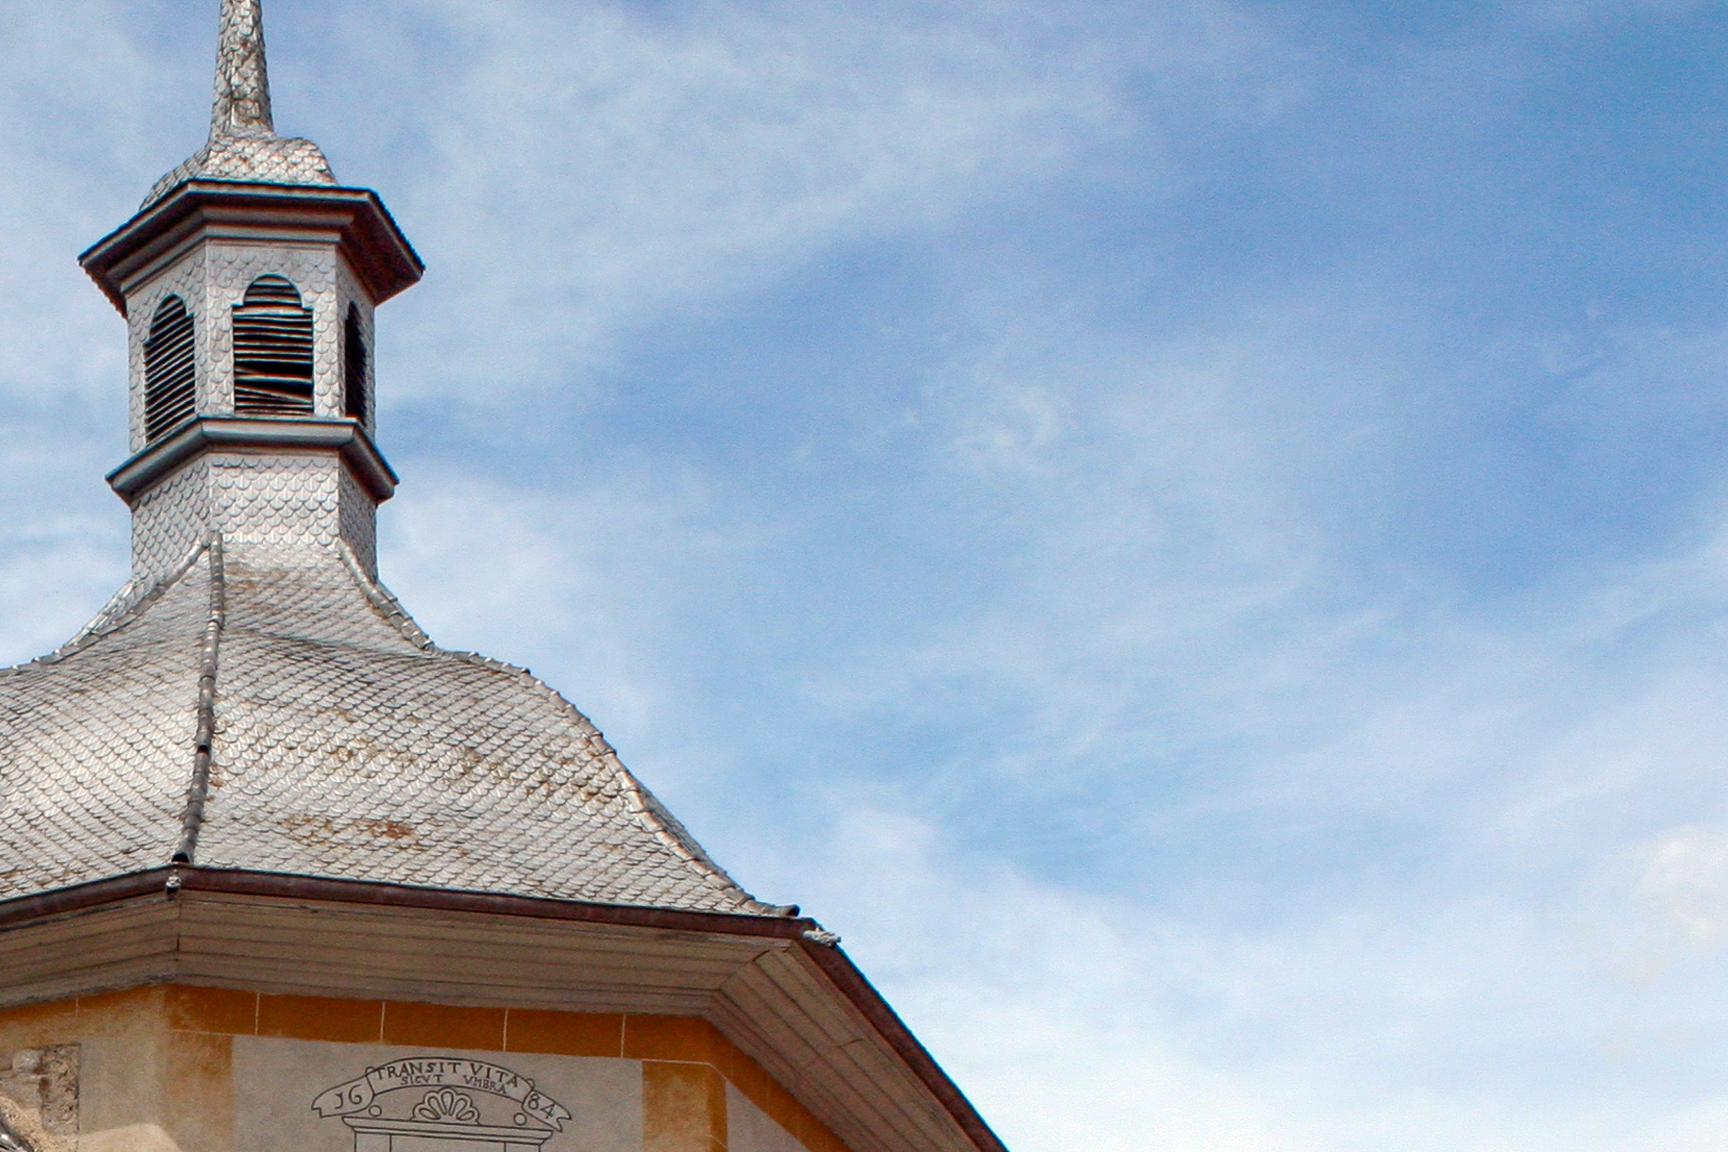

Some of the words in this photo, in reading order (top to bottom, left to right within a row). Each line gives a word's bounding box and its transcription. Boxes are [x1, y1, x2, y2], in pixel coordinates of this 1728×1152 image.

[375, 1061, 461, 1080] TRANSIT
[470, 1063, 518, 1088] VITA
[528, 1093, 556, 1119] 84
